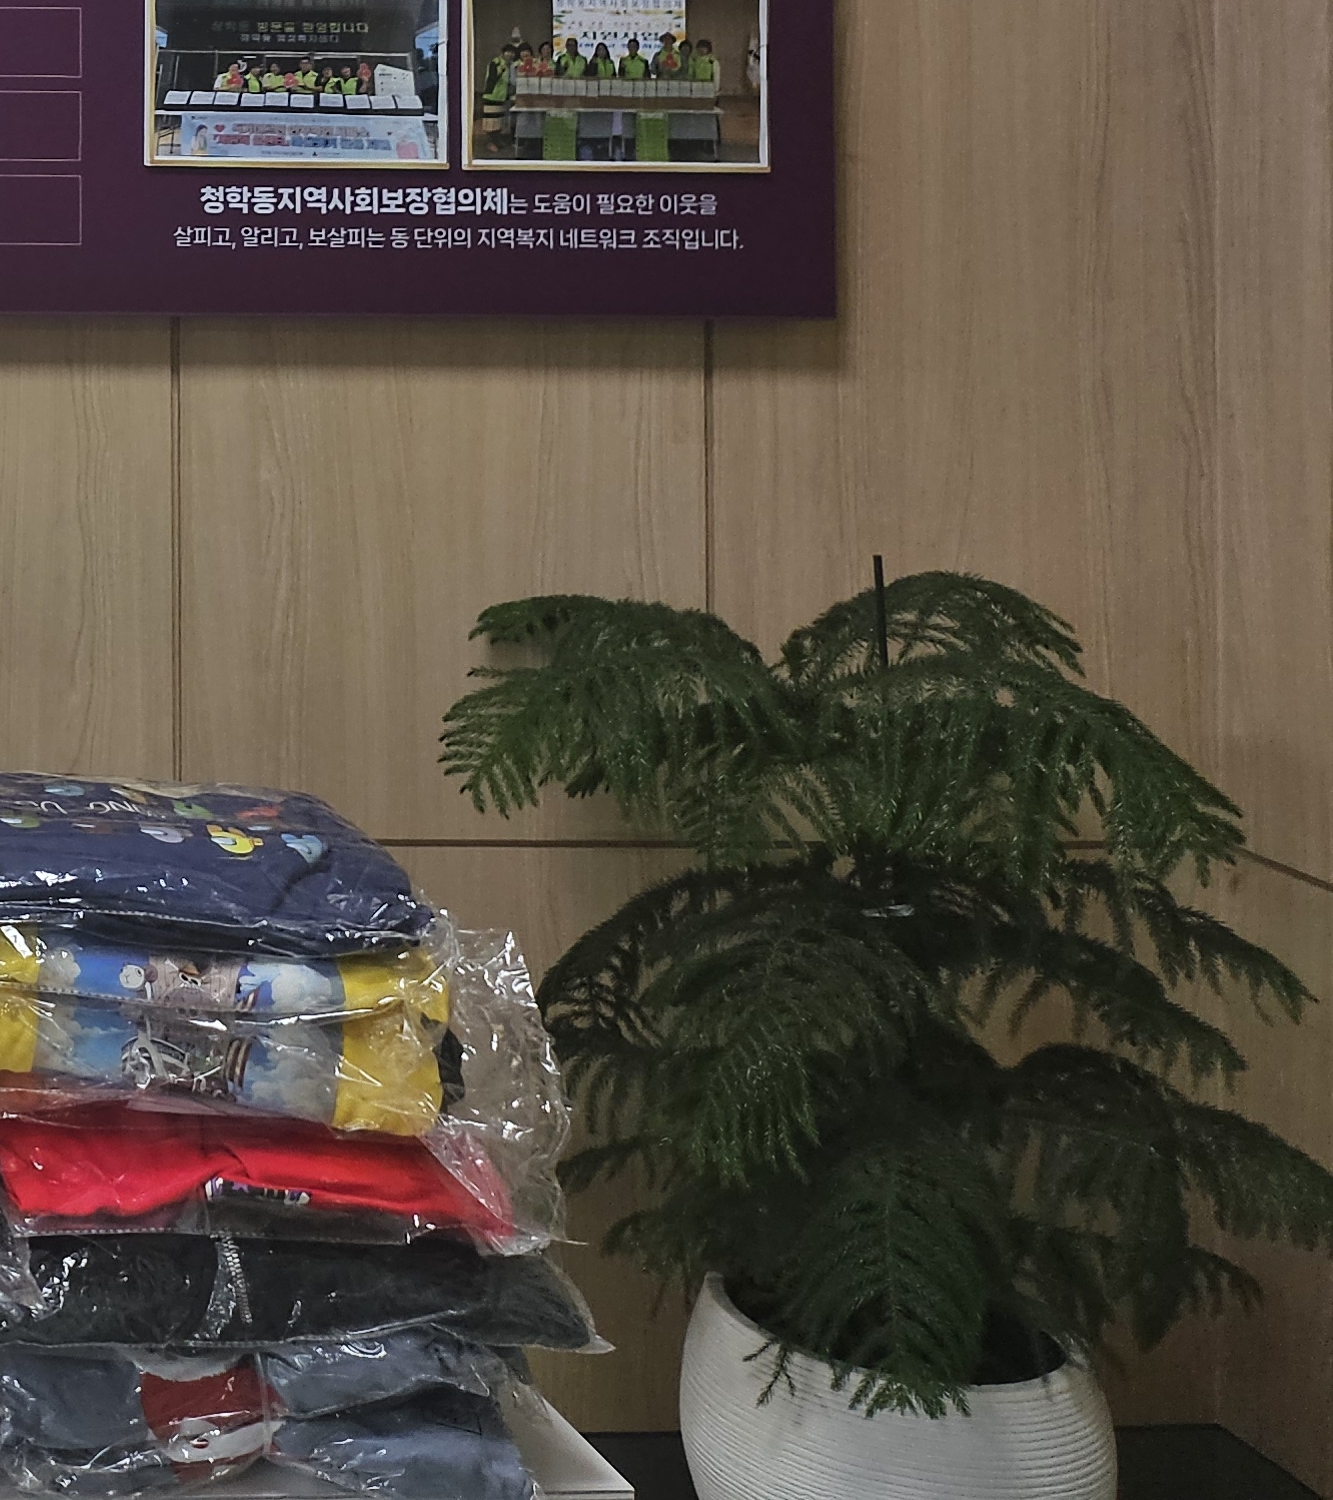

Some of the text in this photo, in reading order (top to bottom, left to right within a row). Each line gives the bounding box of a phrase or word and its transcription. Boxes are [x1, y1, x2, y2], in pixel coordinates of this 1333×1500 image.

[199, 184, 717, 216] 청학동지역사회보장협의체는 도움이 필요한 이웃을
[173, 226, 744, 251] 살피고, 알리고, 보살피는 동 단위의 지역복지 네트워크 조직입니다.
